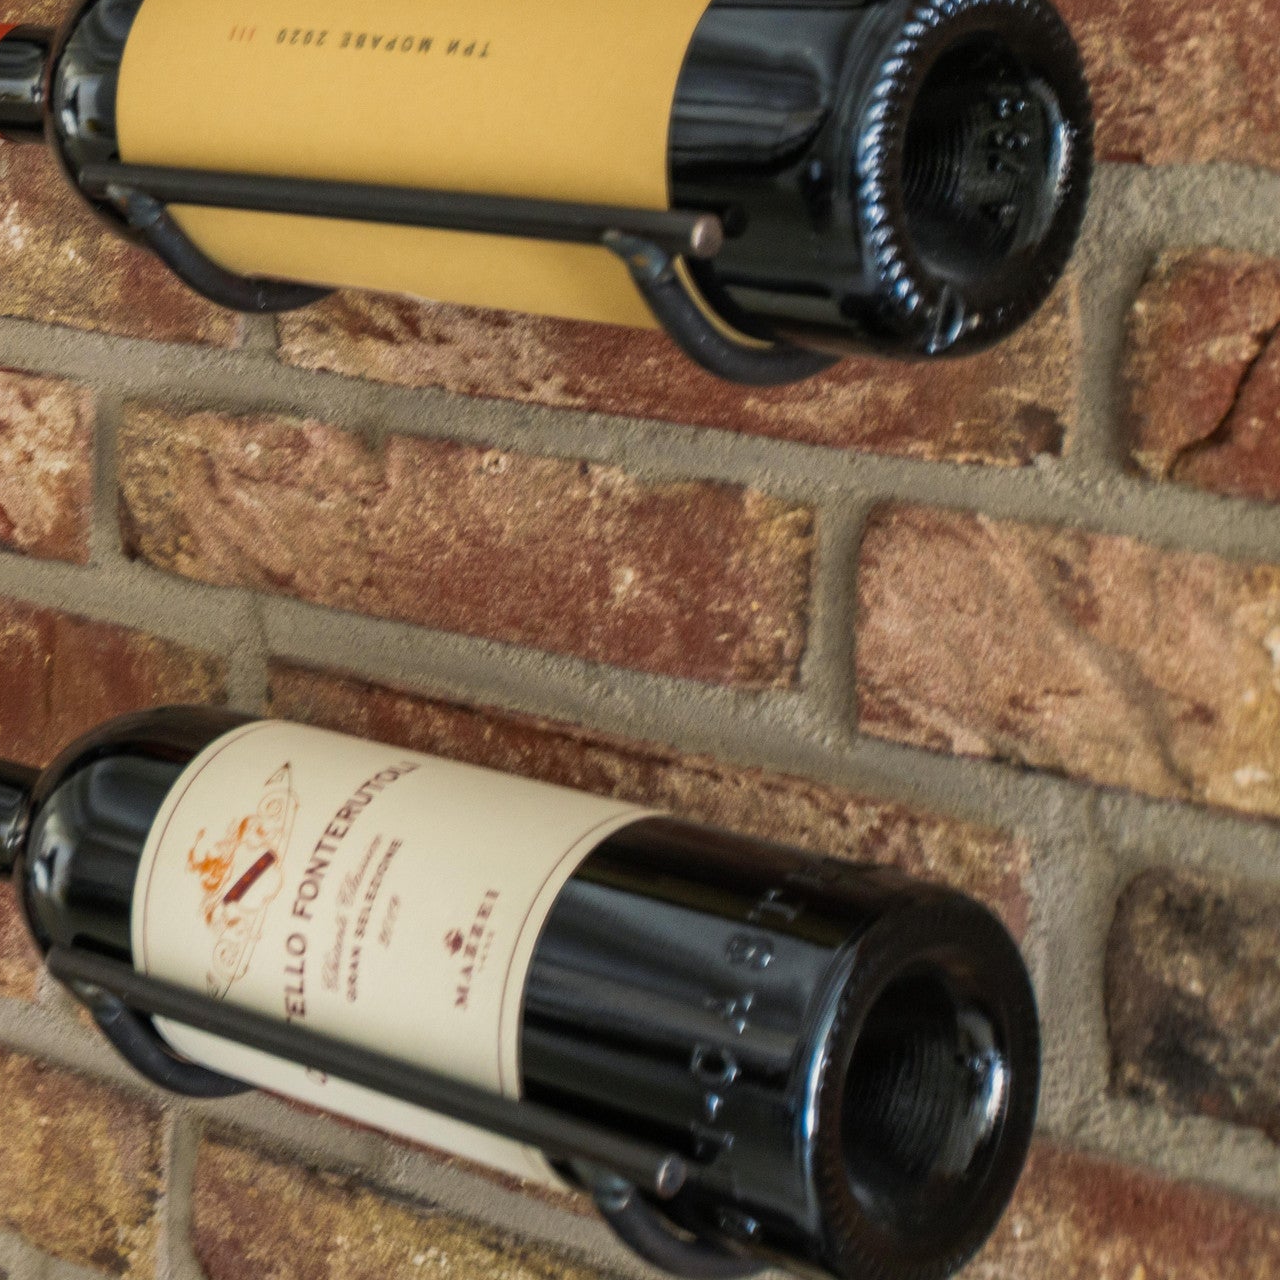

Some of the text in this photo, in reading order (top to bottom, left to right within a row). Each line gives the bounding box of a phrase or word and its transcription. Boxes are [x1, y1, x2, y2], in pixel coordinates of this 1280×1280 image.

[276, 27, 329, 48] 2020
[340, 31, 434, 54] МОРАВЕ
[446, 37, 490, 59] ТРИ
